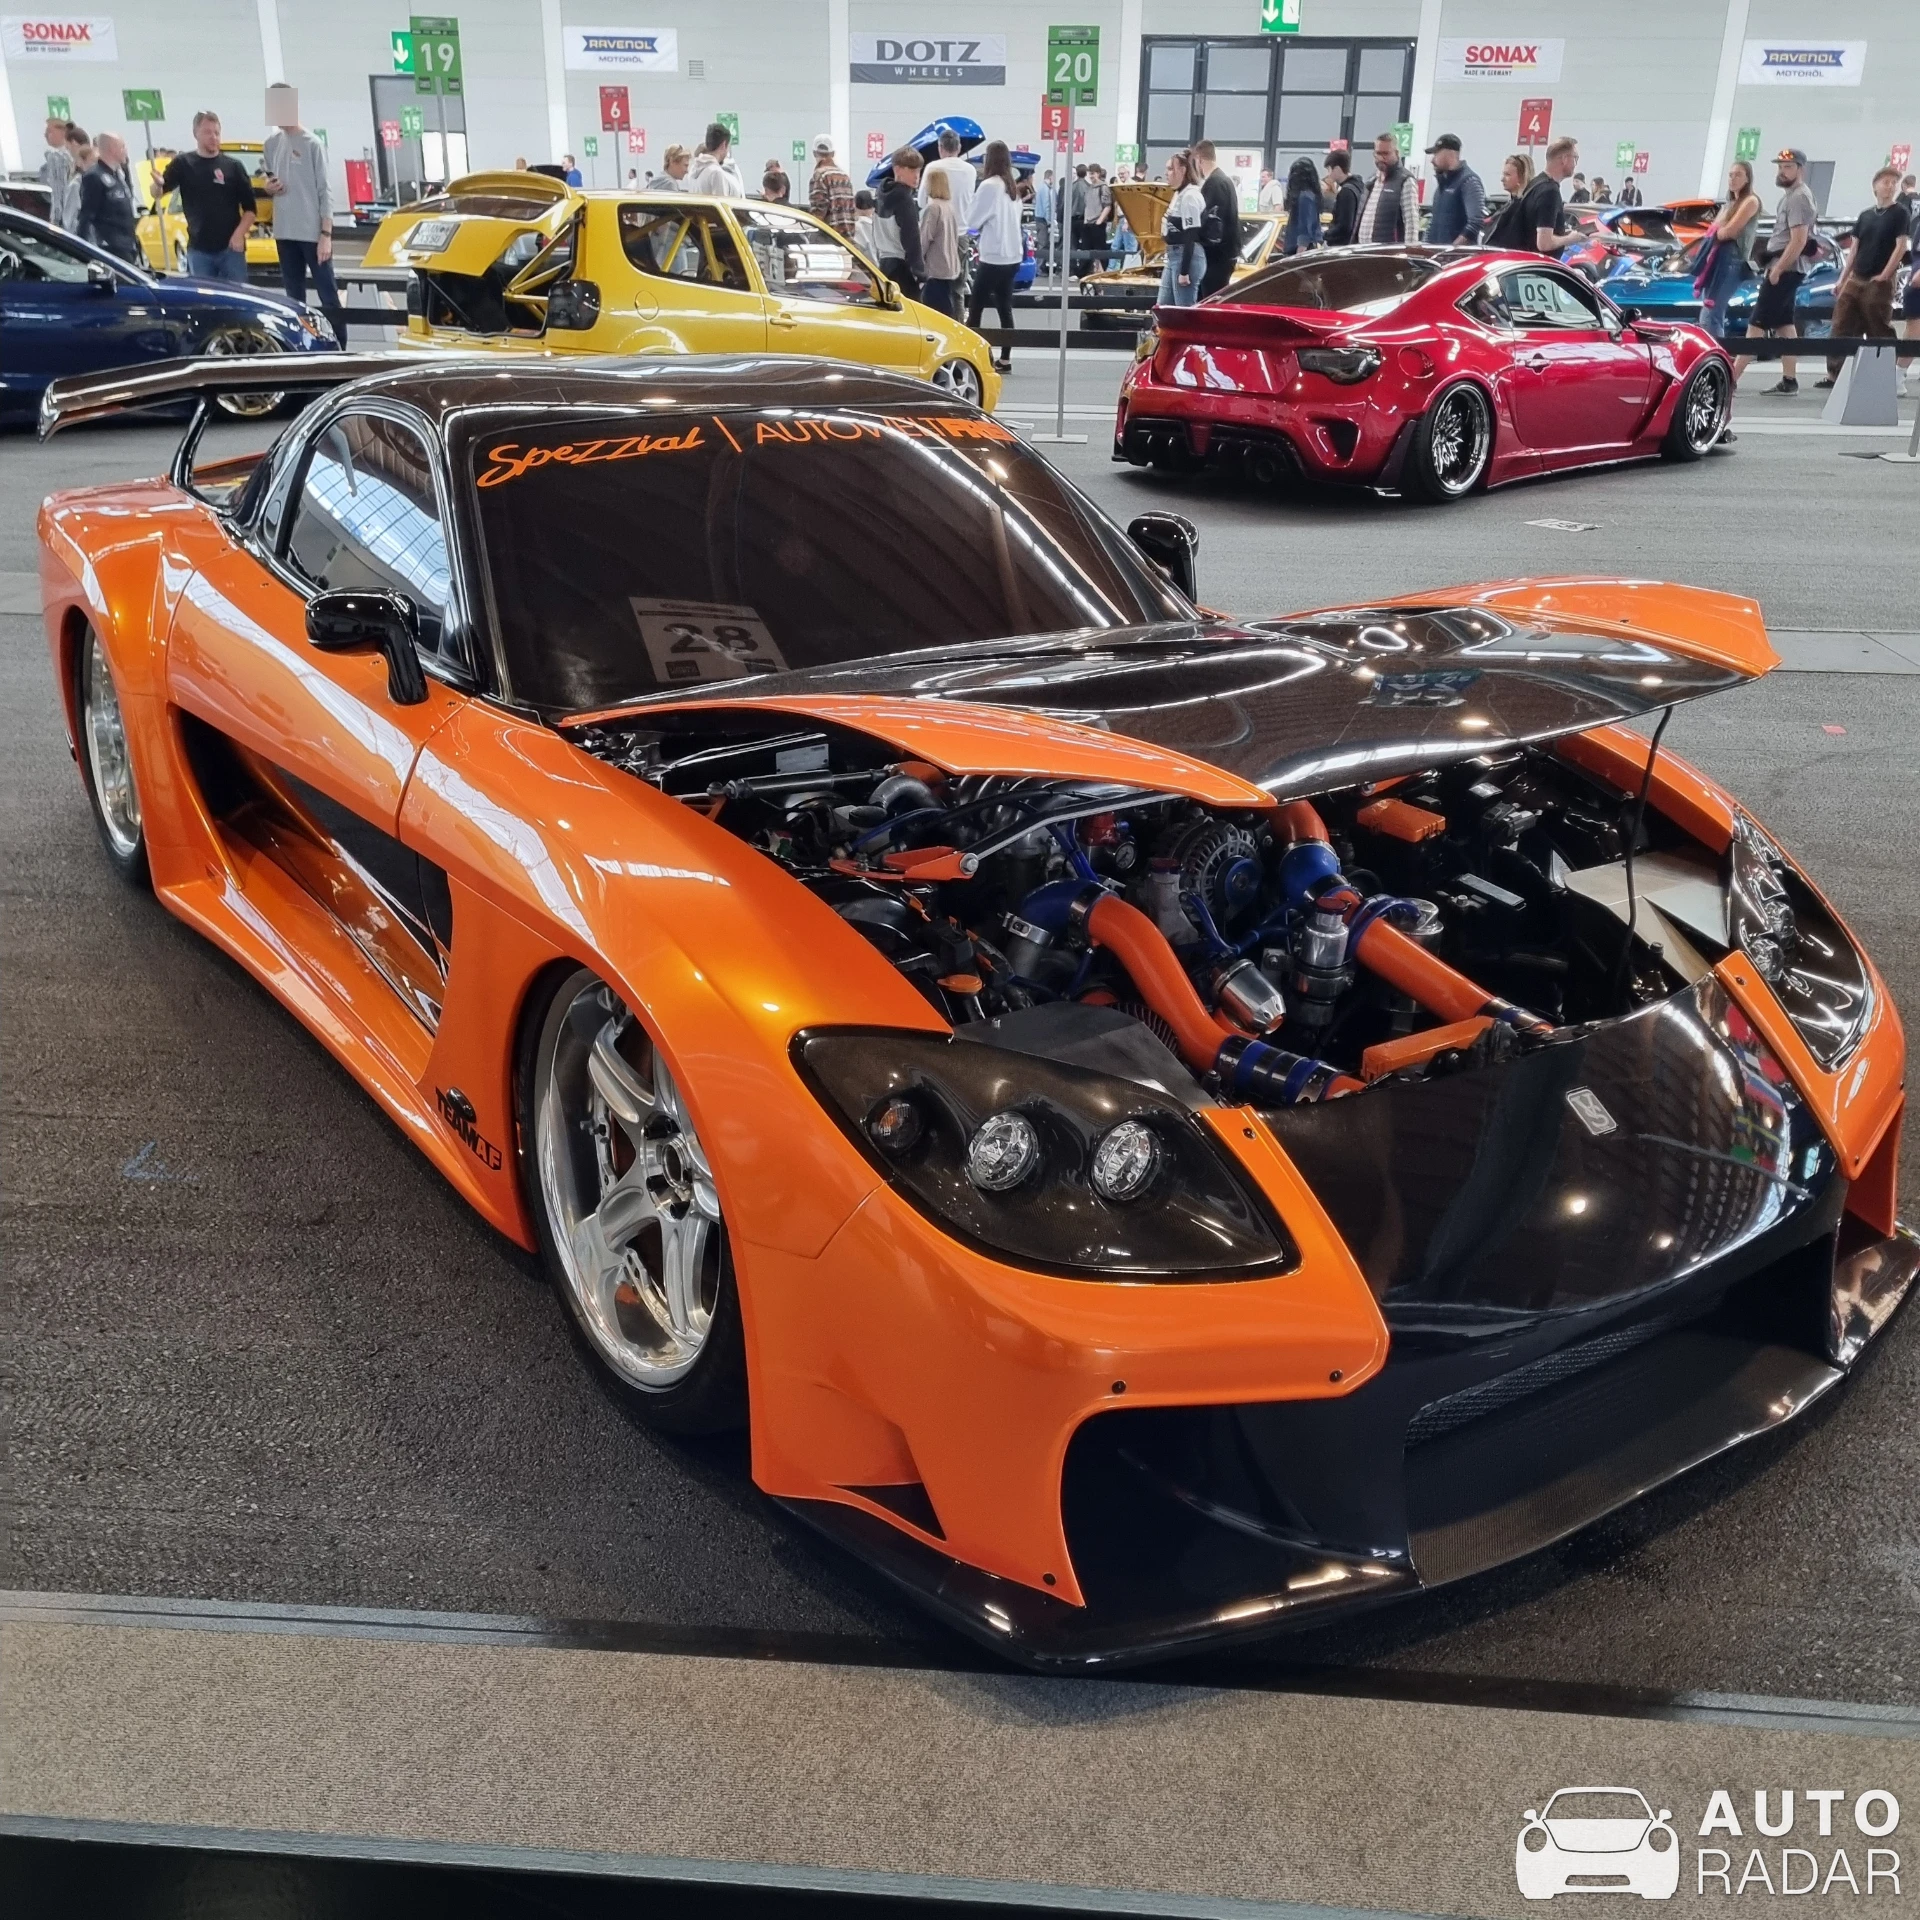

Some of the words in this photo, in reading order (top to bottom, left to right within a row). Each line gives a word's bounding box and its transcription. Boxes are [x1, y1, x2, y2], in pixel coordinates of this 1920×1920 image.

[22, 22, 91, 41] SONAX
[589, 39, 652, 50] RAVENOL
[876, 39, 981, 62] DOTZ
[421, 42, 455, 72] 19
[598, 55, 644, 63] MOTORÖL
[1465, 45, 1538, 63] SONAX
[1769, 53, 1837, 63] RAVENOL
[894, 67, 963, 76] WHEELS
[1054, 53, 1092, 82] 20
[1776, 69, 1824, 77] MOTORÖL
[610, 101, 621, 119] 6
[1051, 109, 1062, 127] 5
[404, 116, 420, 131] 15
[1528, 114, 1540, 132] 4
[869, 141, 882, 152] 35
[1740, 138, 1755, 151] 11
[1893, 154, 1907, 164] 39
[663, 622, 759, 653] 28
